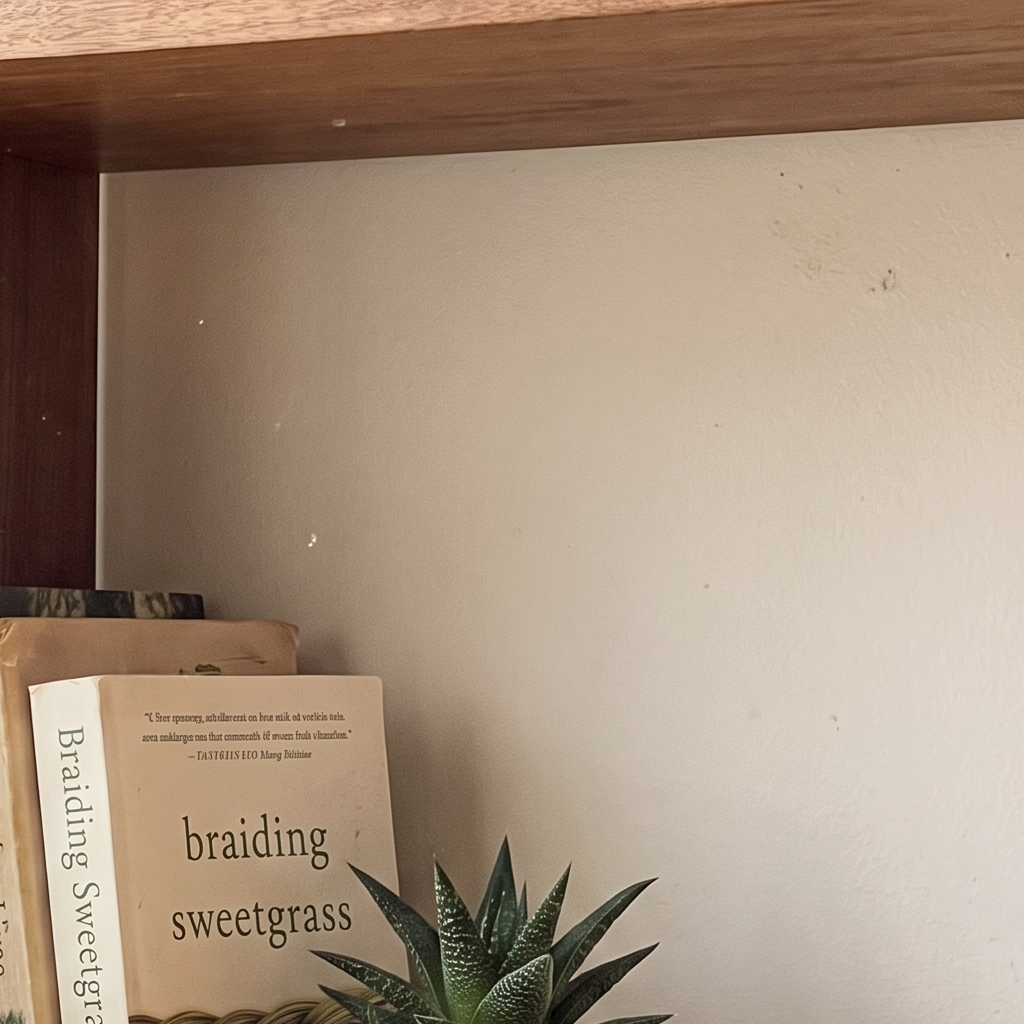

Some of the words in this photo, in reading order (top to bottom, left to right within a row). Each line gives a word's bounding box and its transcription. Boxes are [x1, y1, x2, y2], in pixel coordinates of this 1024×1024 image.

[57, 725, 94, 871] Braiding
[182, 812, 329, 870] braiding
[171, 901, 352, 949] sweetgrass
